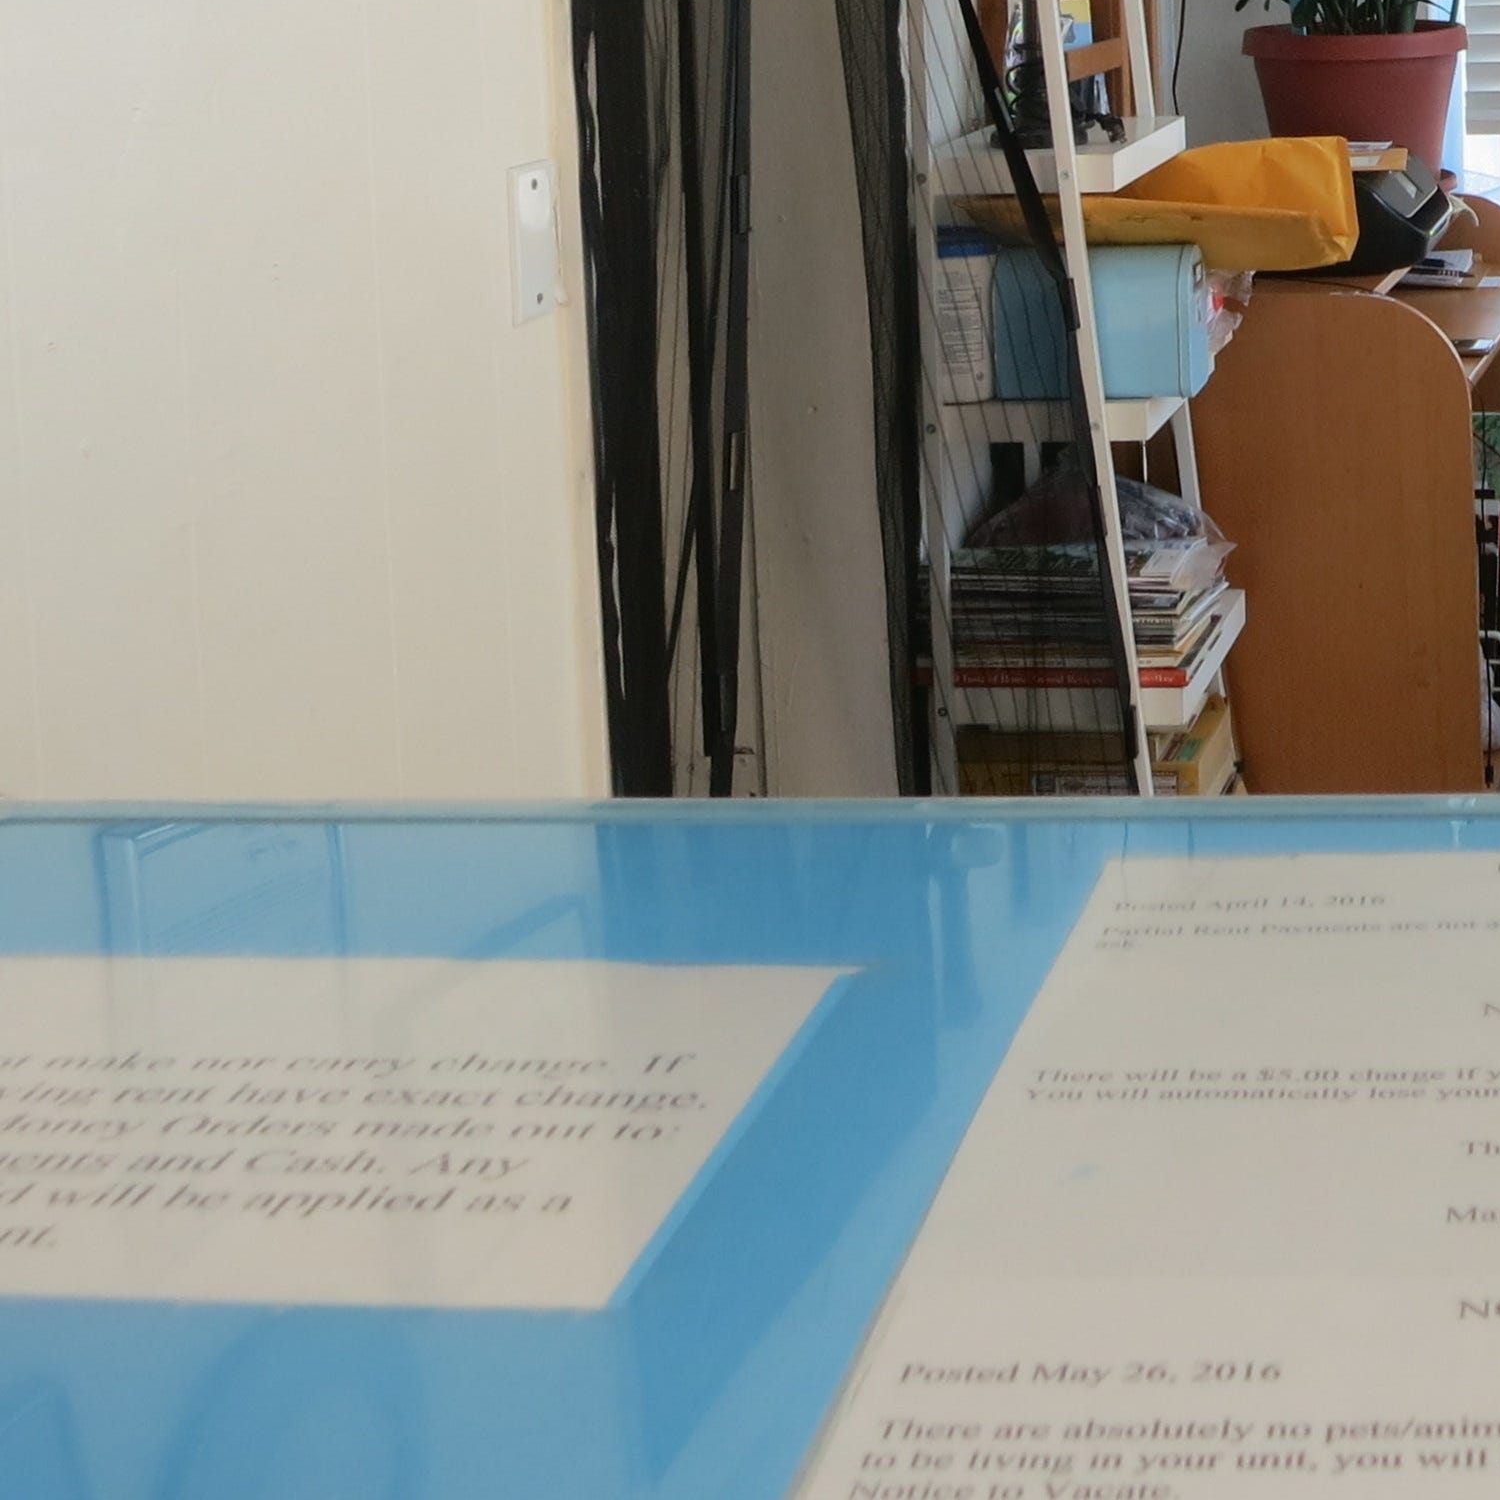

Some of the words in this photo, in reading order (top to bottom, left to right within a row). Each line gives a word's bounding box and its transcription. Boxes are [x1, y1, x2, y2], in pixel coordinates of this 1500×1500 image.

[1114, 901, 1199, 911] Posted
[1208, 898, 1270, 912] April
[1323, 895, 1386, 906] 2016
[1193, 925, 1250, 935] Rent
[1259, 924, 1381, 936] Payments
[1437, 920, 1477, 930] not
[44, 1051, 177, 1071] make
[189, 1057, 278, 1070] nor
[284, 1056, 417, 1079] carry
[642, 1052, 696, 1073] If
[1038, 1069, 1109, 1082] There
[1124, 1068, 1179, 1081] will
[1188, 1068, 1221, 1081] be
[1258, 1068, 1339, 1081] $5.00
[1348, 1067, 1442, 1084] charge
[1456, 1067, 1479, 1080] if
[113, 1085, 217, 1103] rent
[227, 1082, 352, 1104] have
[362, 1087, 500, 1106] exact
[514, 1084, 706, 1113] change.
[1027, 1088, 1081, 1100] You
[1096, 1088, 1149, 1100] will
[1159, 1088, 1358, 1103] automatically
[1368, 1087, 1426, 1099] lose
[161, 1115, 339, 1136] Orders
[351, 1117, 496, 1138] made
[508, 1122, 596, 1140] out
[0, 1153, 117, 1172] ents
[126, 1148, 238, 1172] and
[245, 1148, 386, 1175] Cash.
[406, 1151, 531, 1180] Any
[47, 1182, 157, 1208] will
[162, 1182, 231, 1208] be
[241, 1185, 457, 1218] applied
[463, 1195, 527, 1212] as
[539, 1196, 574, 1212] a
[899, 1362, 1021, 1382] Posted
[1032, 1362, 1113, 1387] May
[1121, 1361, 1177, 1384] 26,
[1189, 1360, 1283, 1382] 2016
[880, 1418, 984, 1440] There
[993, 1423, 1051, 1440] are
[1063, 1417, 1256, 1445] absolutely
[1267, 1423, 1314, 1438] no
[861, 1449, 897, 1469] to
[910, 1448, 954, 1469] be
[966, 1448, 1075, 1475] living
[1088, 1450, 1122, 1469] in
[1131, 1453, 1219, 1477] your
[1235, 1450, 1319, 1473] unit,
[1328, 1453, 1403, 1478] you
[1417, 1448, 1488, 1468] will
[847, 1480, 975, 1500] Notice
[986, 1482, 1024, 1500] to
[1044, 1479, 1179, 1500] Vacate.
